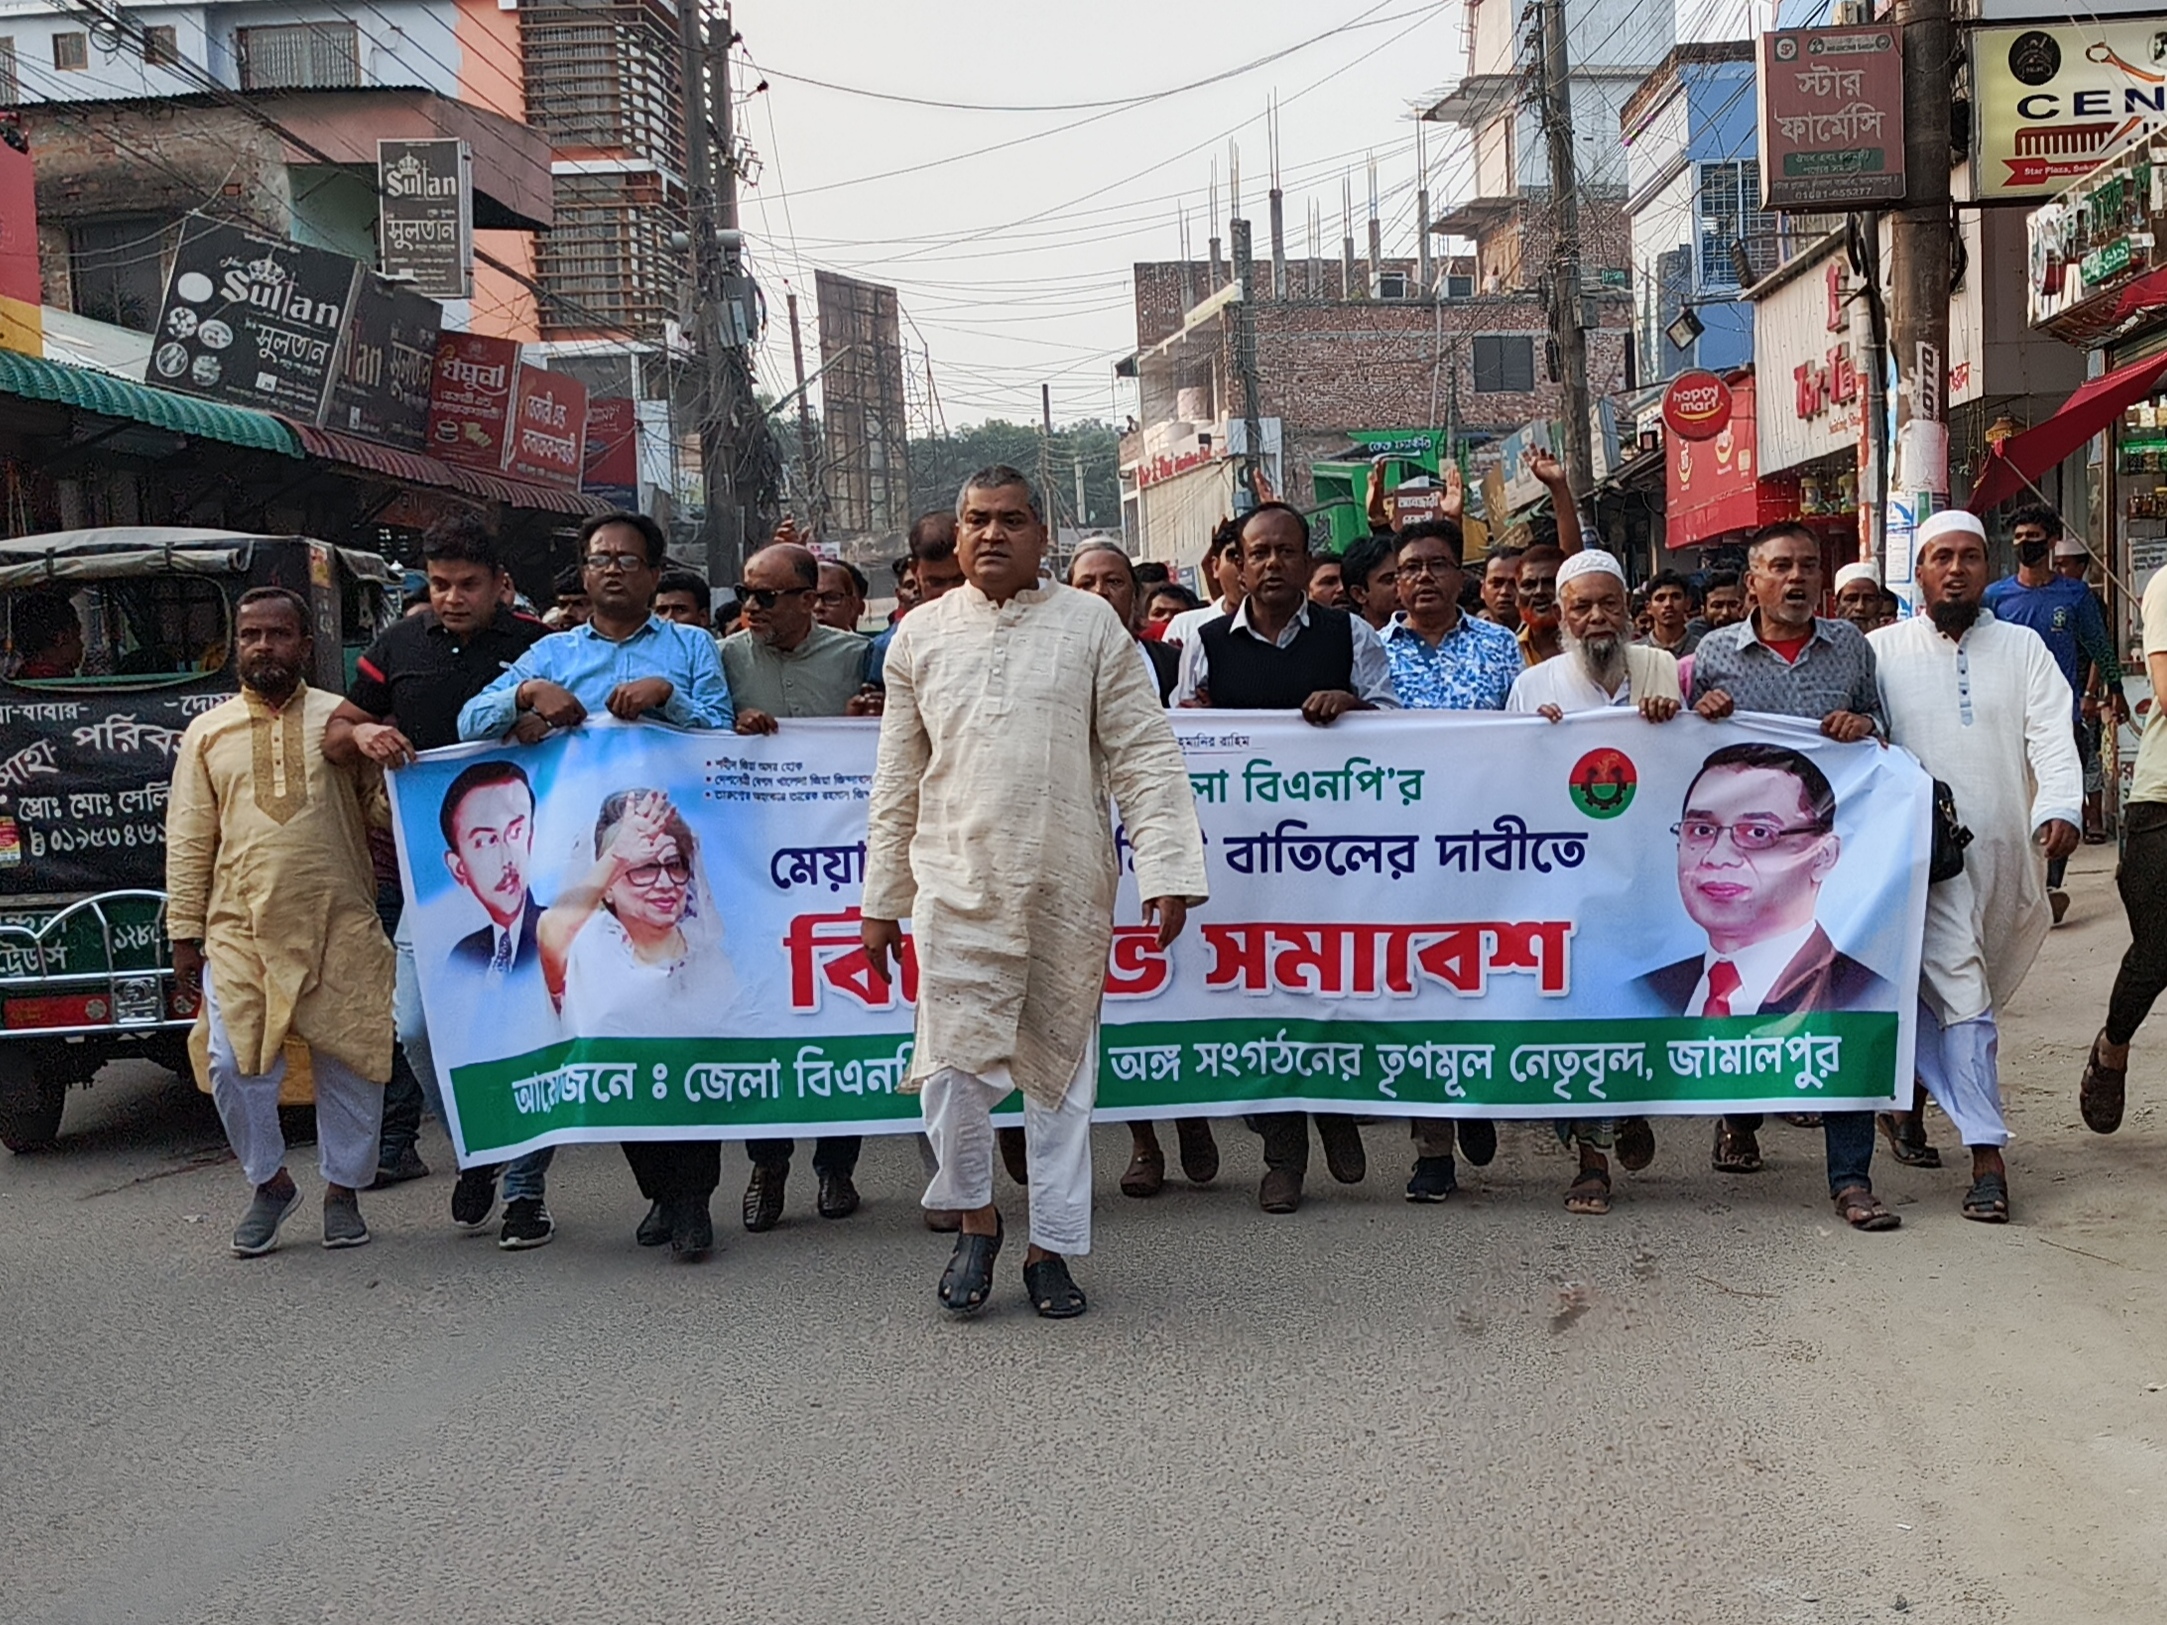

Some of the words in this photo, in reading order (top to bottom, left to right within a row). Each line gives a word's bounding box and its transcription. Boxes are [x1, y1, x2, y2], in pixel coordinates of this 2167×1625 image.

[1794, 63, 1866, 100] স্টার
[1774, 101, 1886, 145] ফার্মেসি
[387, 160, 457, 200] Sultan
[2024, 165, 2043, 177] Star
[387, 219, 457, 251] সুলতান
[220, 269, 339, 328] Sultan
[255, 323, 332, 366] সুলতান
[441, 358, 508, 396] যমুনা
[1673, 384, 1719, 402] happy
[1680, 396, 1717, 413] mart
[1176, 732, 1215, 750] হমানির
[19, 796, 62, 821] প্রোঃ
[69, 793, 113, 818] মোঃ
[119, 781, 172, 813] সেলি
[1189, 768, 1229, 803] লা
[1242, 756, 1425, 806] বিএনপি’র
[771, 840, 867, 892] মেয়া
[1223, 818, 1419, 880] বাতিলের
[1434, 814, 1588, 873] দাবীতে
[1200, 921, 1572, 993] সমাবেশ
[511, 1062, 637, 1115] আয়োজনে
[684, 1058, 780, 1102] জেলা
[1108, 1044, 1182, 1082] অঙ্গ
[1194, 1028, 1363, 1081] সংগঠনের
[1376, 1041, 1495, 1098] তৃণমূল
[1510, 1041, 1653, 1100] নেতৃবৃন্দ,
[1666, 1031, 1842, 1090] জামালপুর
